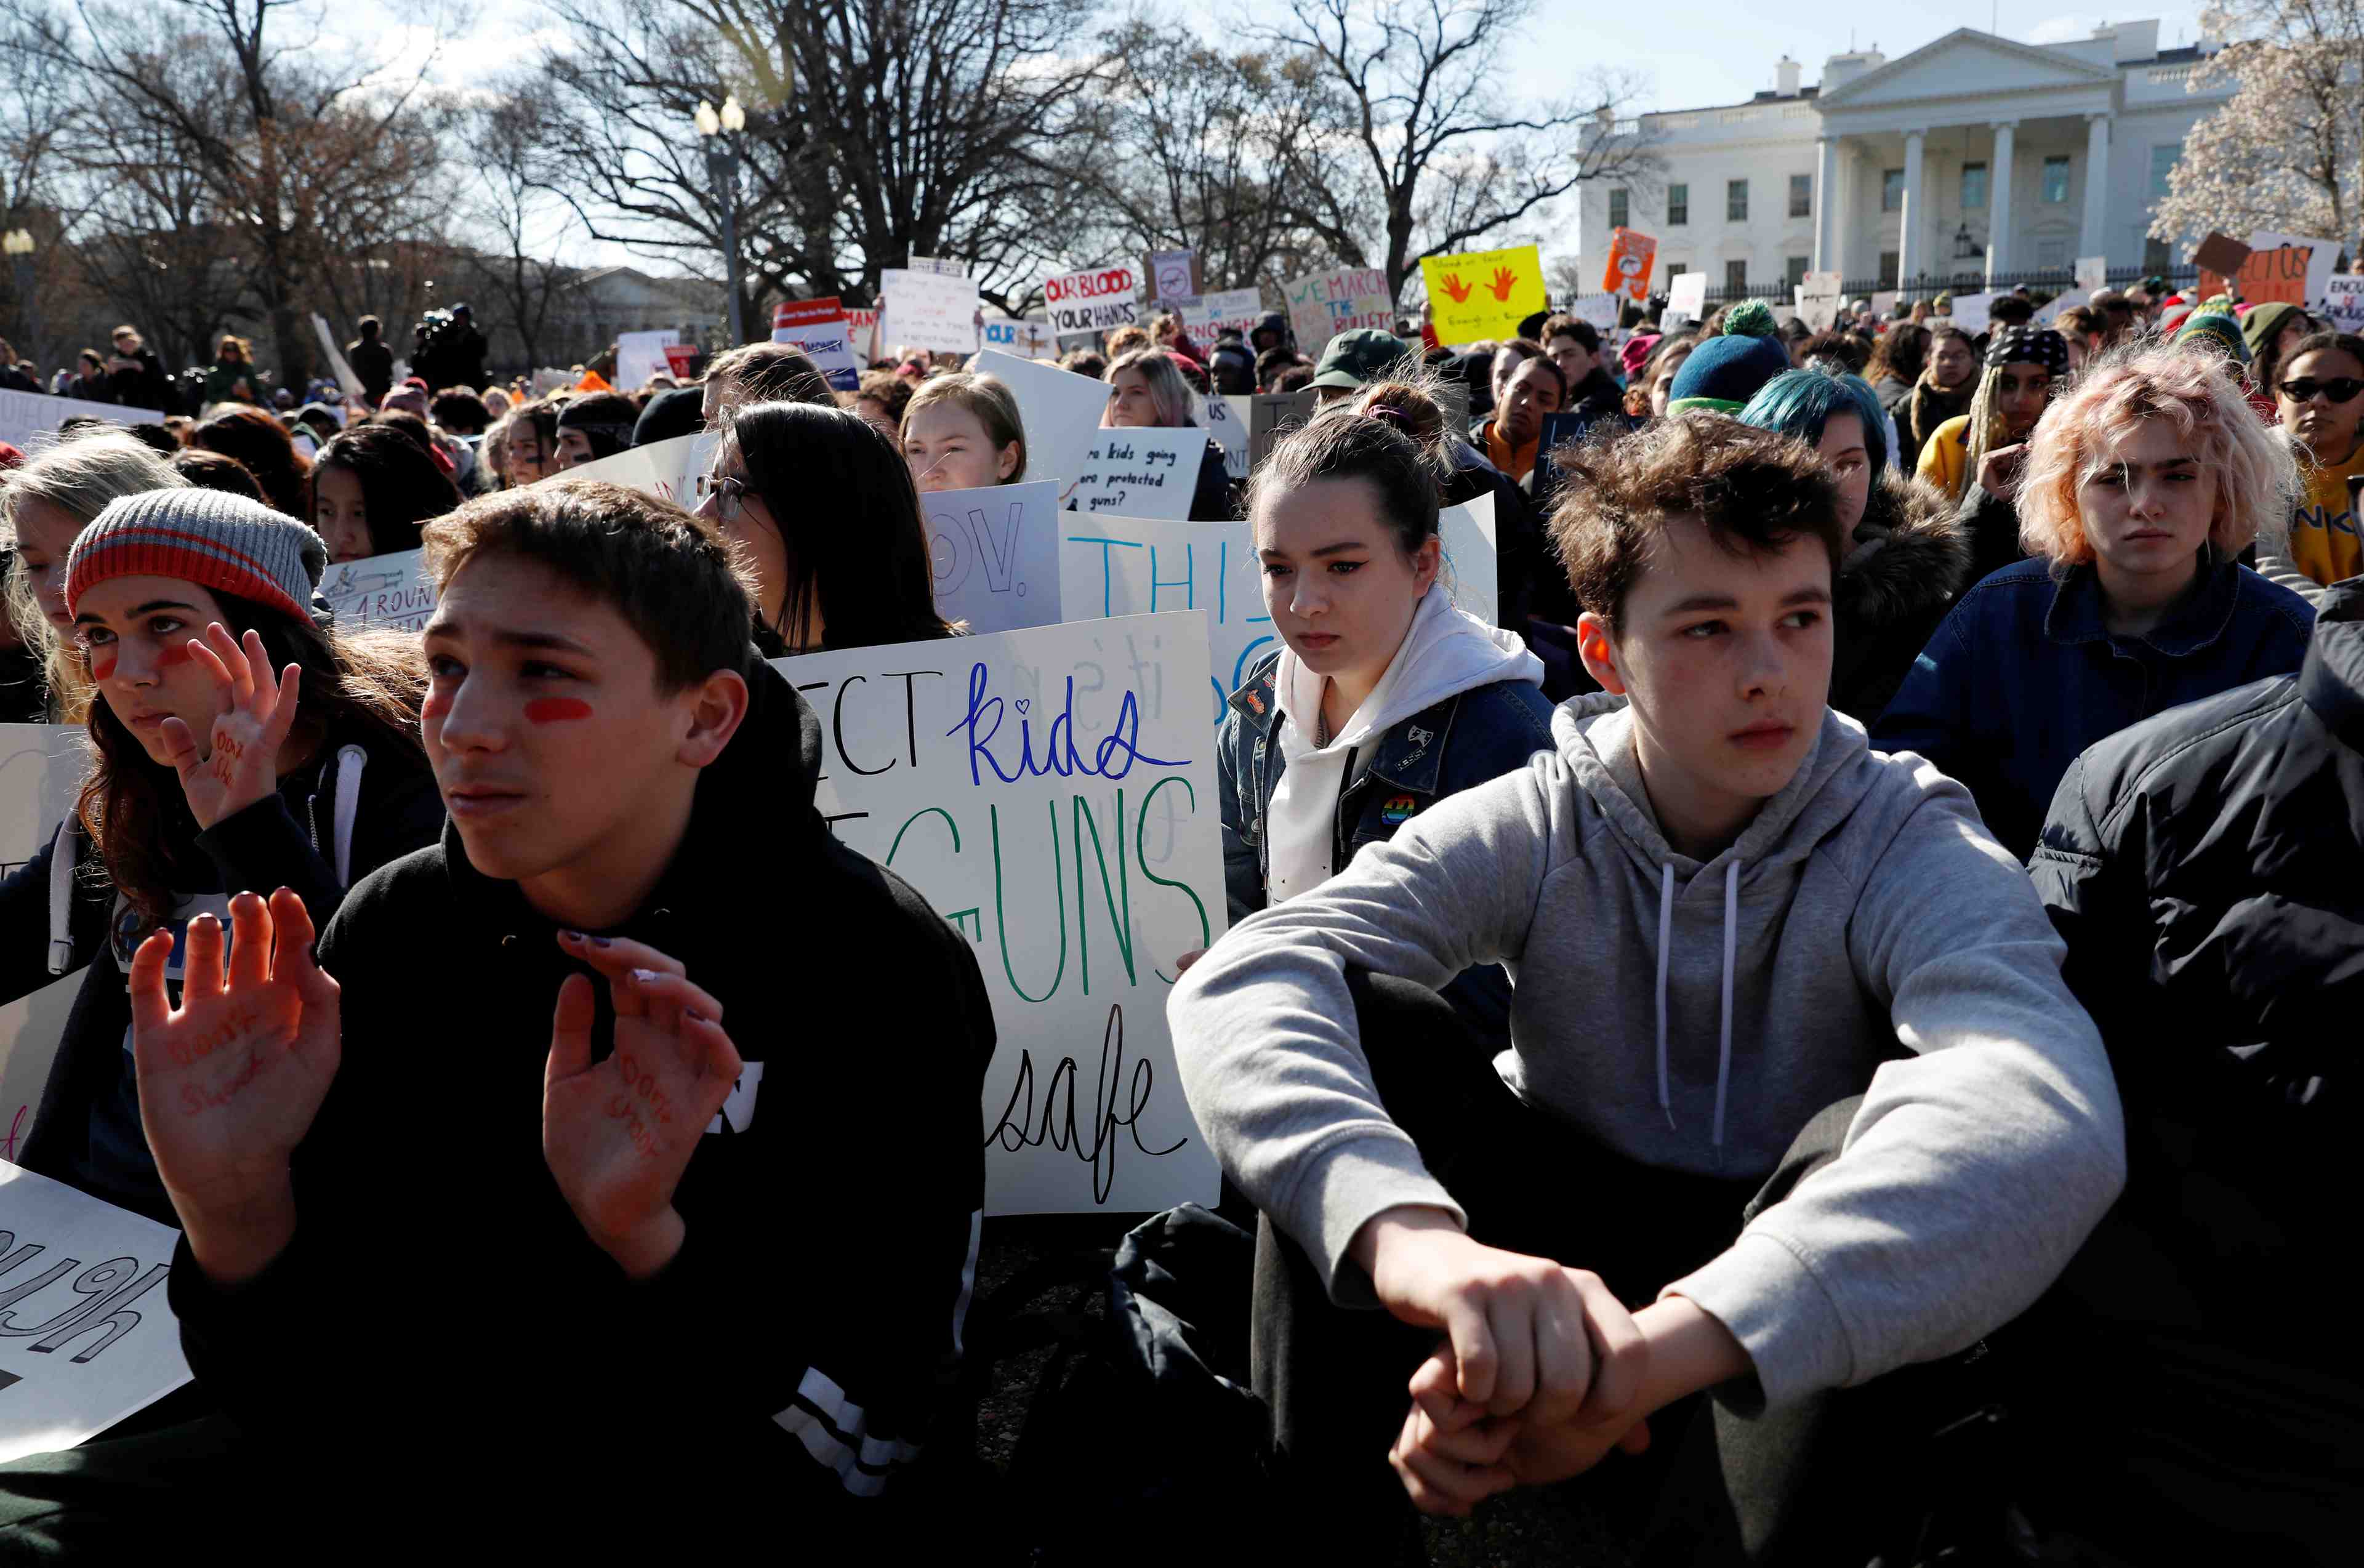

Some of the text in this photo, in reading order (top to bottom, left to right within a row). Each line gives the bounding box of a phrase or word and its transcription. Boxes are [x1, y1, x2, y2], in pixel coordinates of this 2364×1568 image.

[1047, 268, 1133, 302] OUR BLOOD
[1327, 268, 1393, 300] MARCH
[1051, 302, 1136, 331] YOUR HANDS
[1208, 402, 1226, 421] US
[1107, 441, 1135, 460] kids
[1145, 449, 1177, 467] going
[1106, 471, 1165, 488] protected
[1089, 490, 1127, 511] guns?
[1067, 537, 1272, 625] THI
[377, 584, 435, 617] ROUN
[797, 670, 944, 777] CT
[946, 662, 1192, 786] kids
[985, 1003, 1188, 1205] safe
